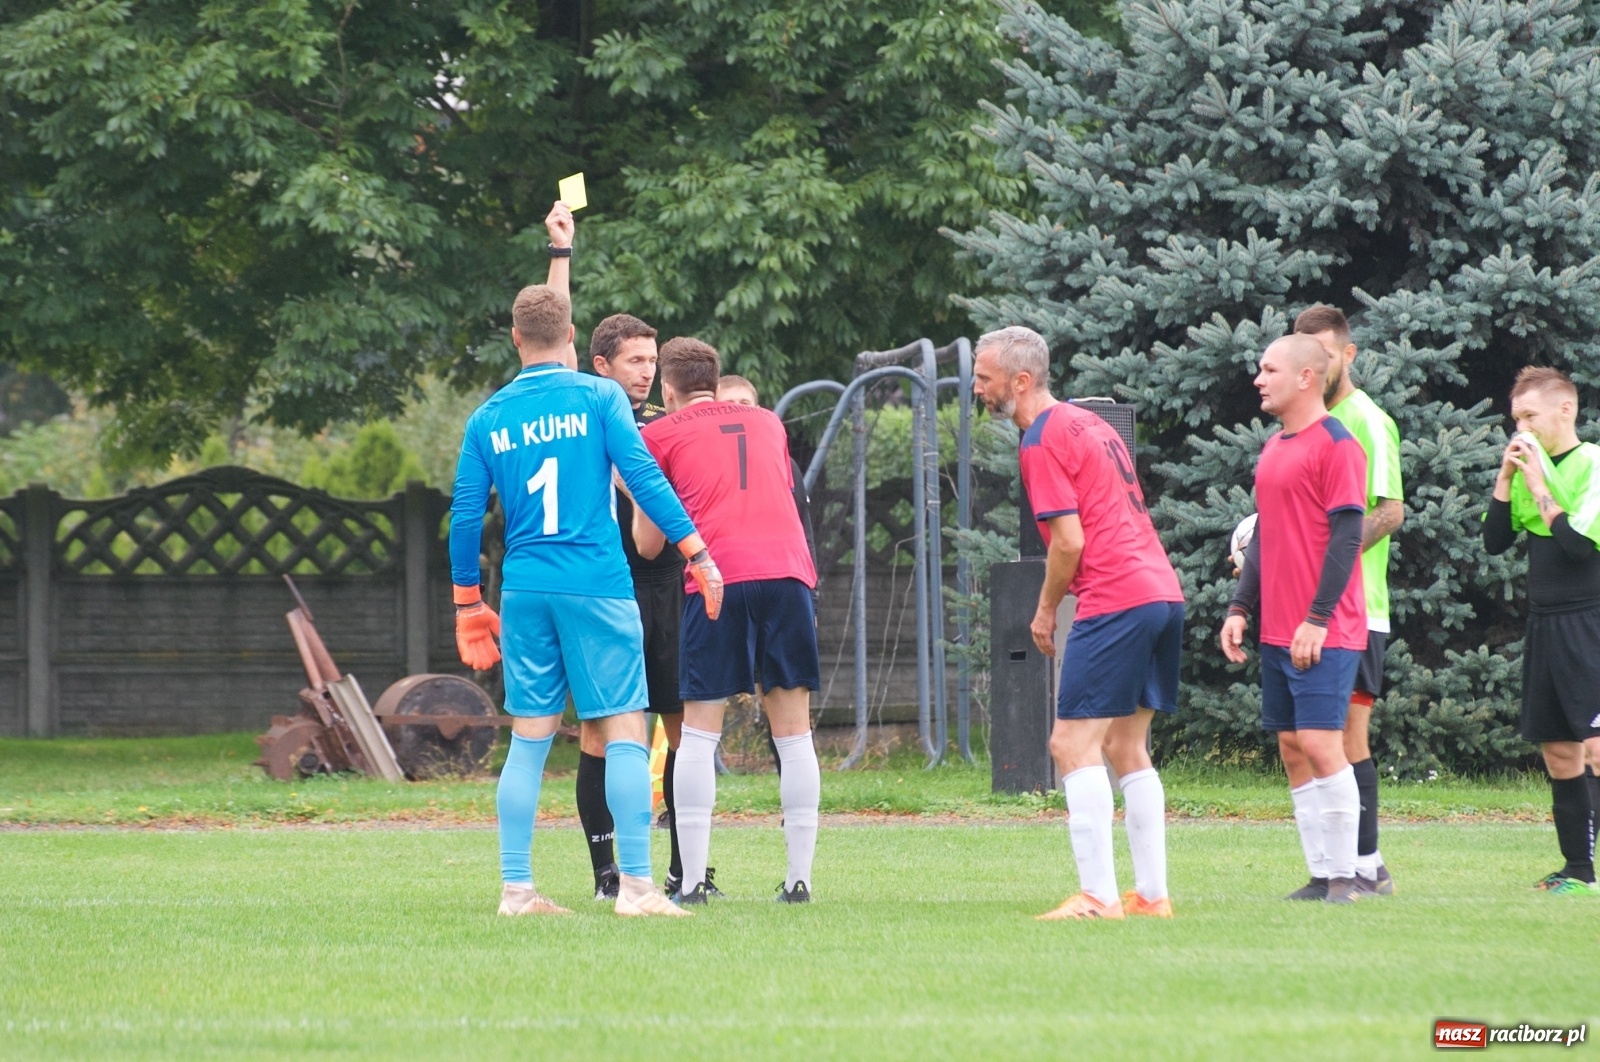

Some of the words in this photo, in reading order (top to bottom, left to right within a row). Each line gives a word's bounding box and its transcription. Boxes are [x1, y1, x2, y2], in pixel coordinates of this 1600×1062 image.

[491, 428, 517, 454] M.
[523, 413, 587, 446] KÜHN
[671, 412, 693, 425] LKS
[719, 423, 746, 490] 7
[526, 457, 558, 535] 1
